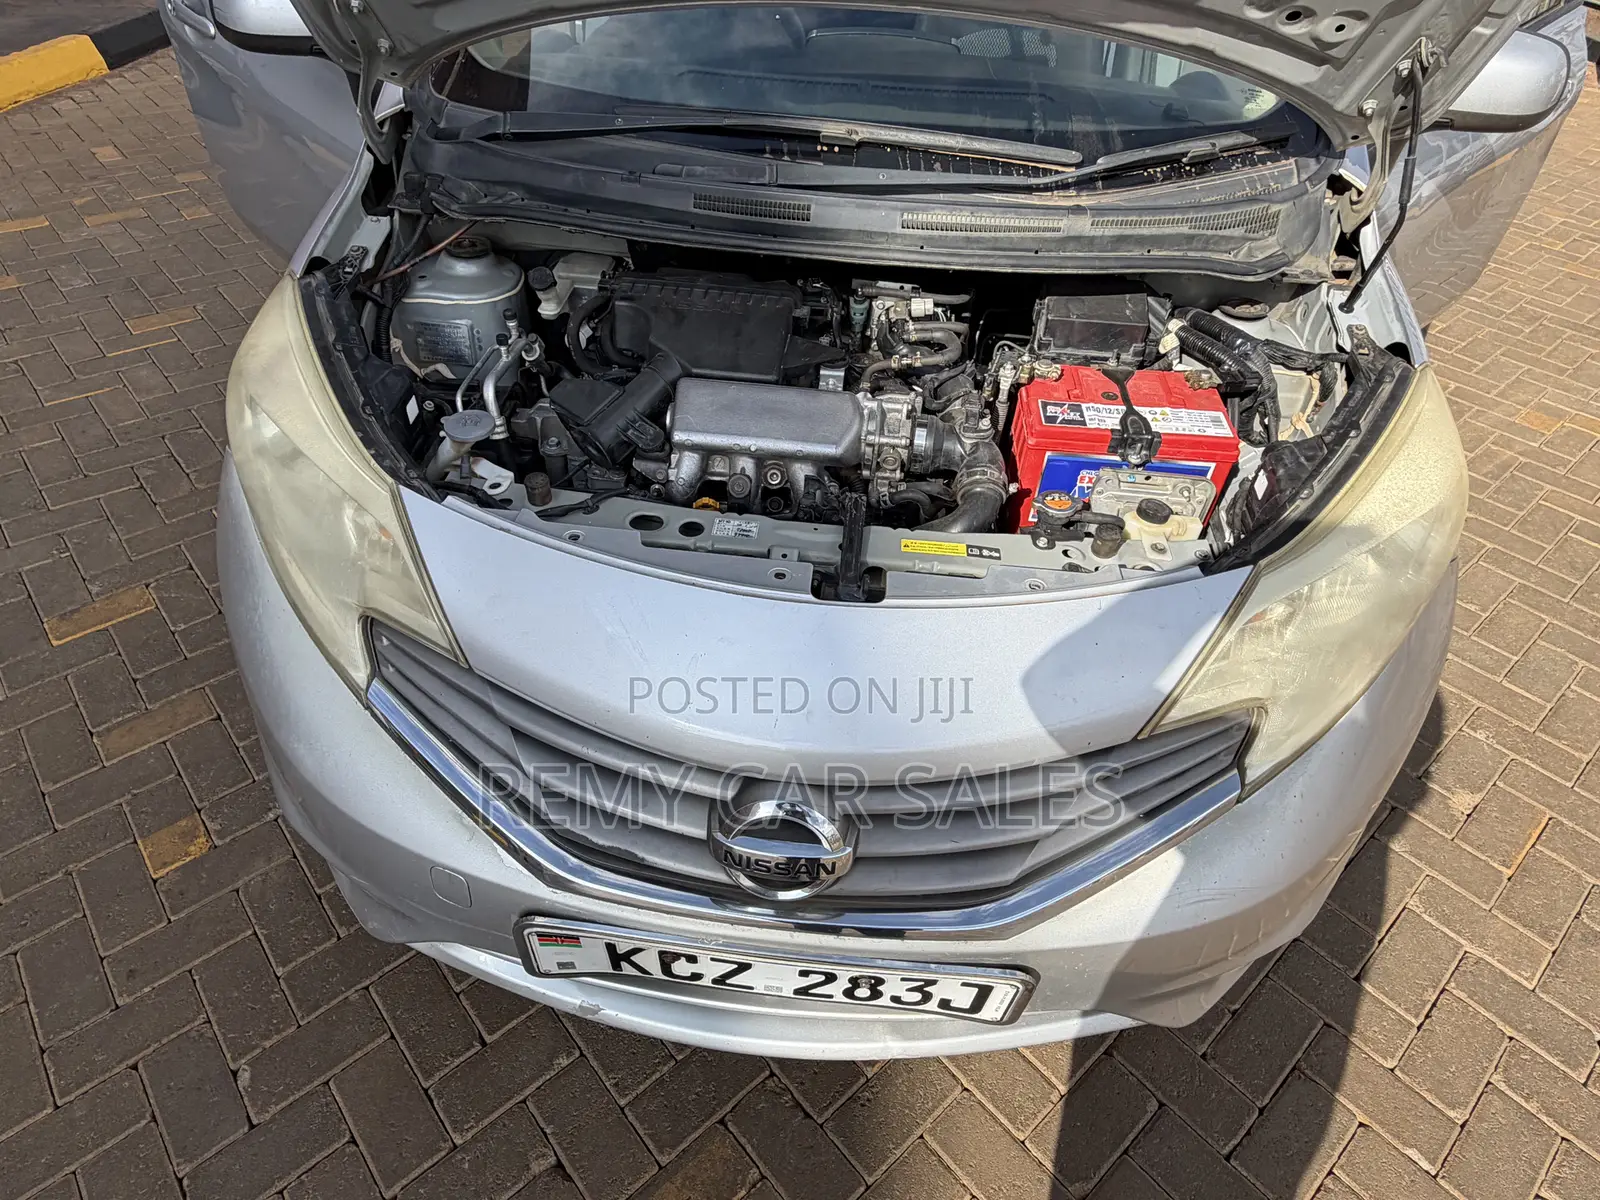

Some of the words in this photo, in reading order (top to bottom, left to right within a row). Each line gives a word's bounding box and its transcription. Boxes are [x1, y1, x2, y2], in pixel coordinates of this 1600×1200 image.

[723, 849, 836, 877] NISSAN
[603, 941, 755, 991] KCZ
[792, 969, 995, 1015] 283J
